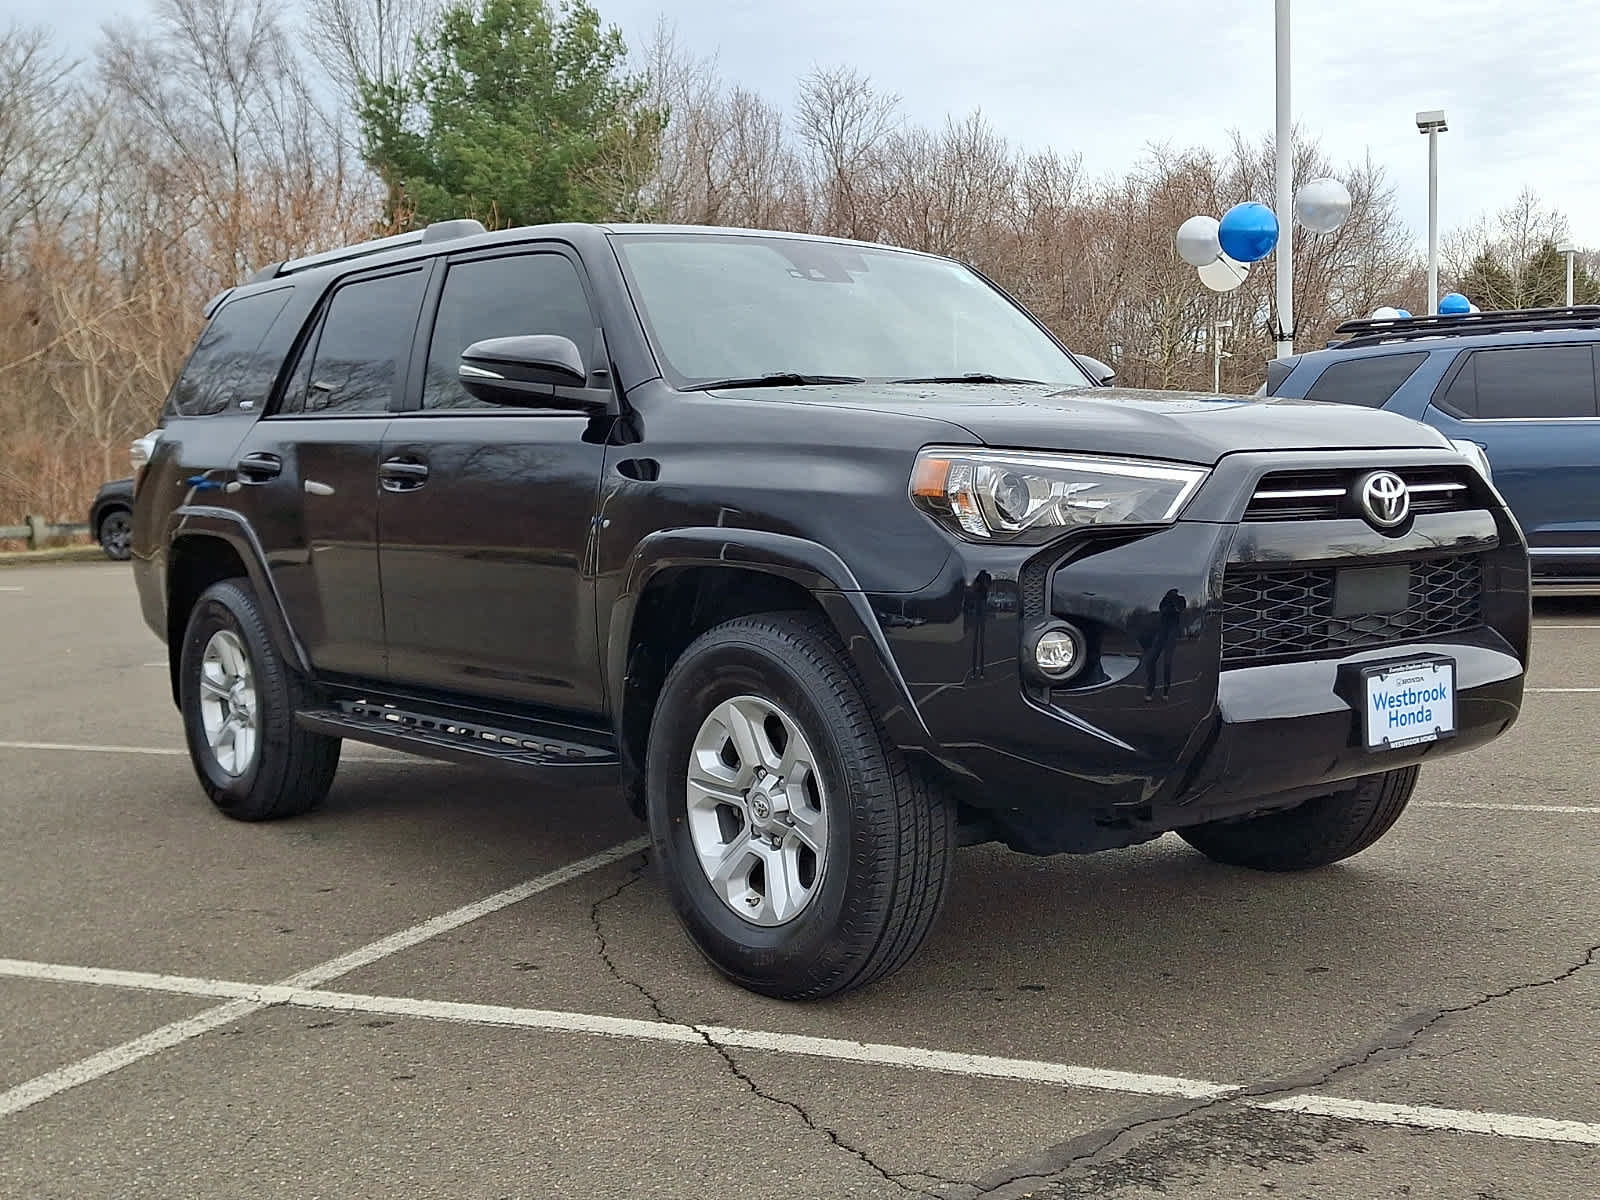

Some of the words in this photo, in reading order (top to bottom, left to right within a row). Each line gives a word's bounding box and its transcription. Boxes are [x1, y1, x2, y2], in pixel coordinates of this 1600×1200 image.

[1402, 676, 1425, 685] HONDA
[1373, 682, 1447, 711] Westbrook
[1388, 705, 1432, 728] Honda
